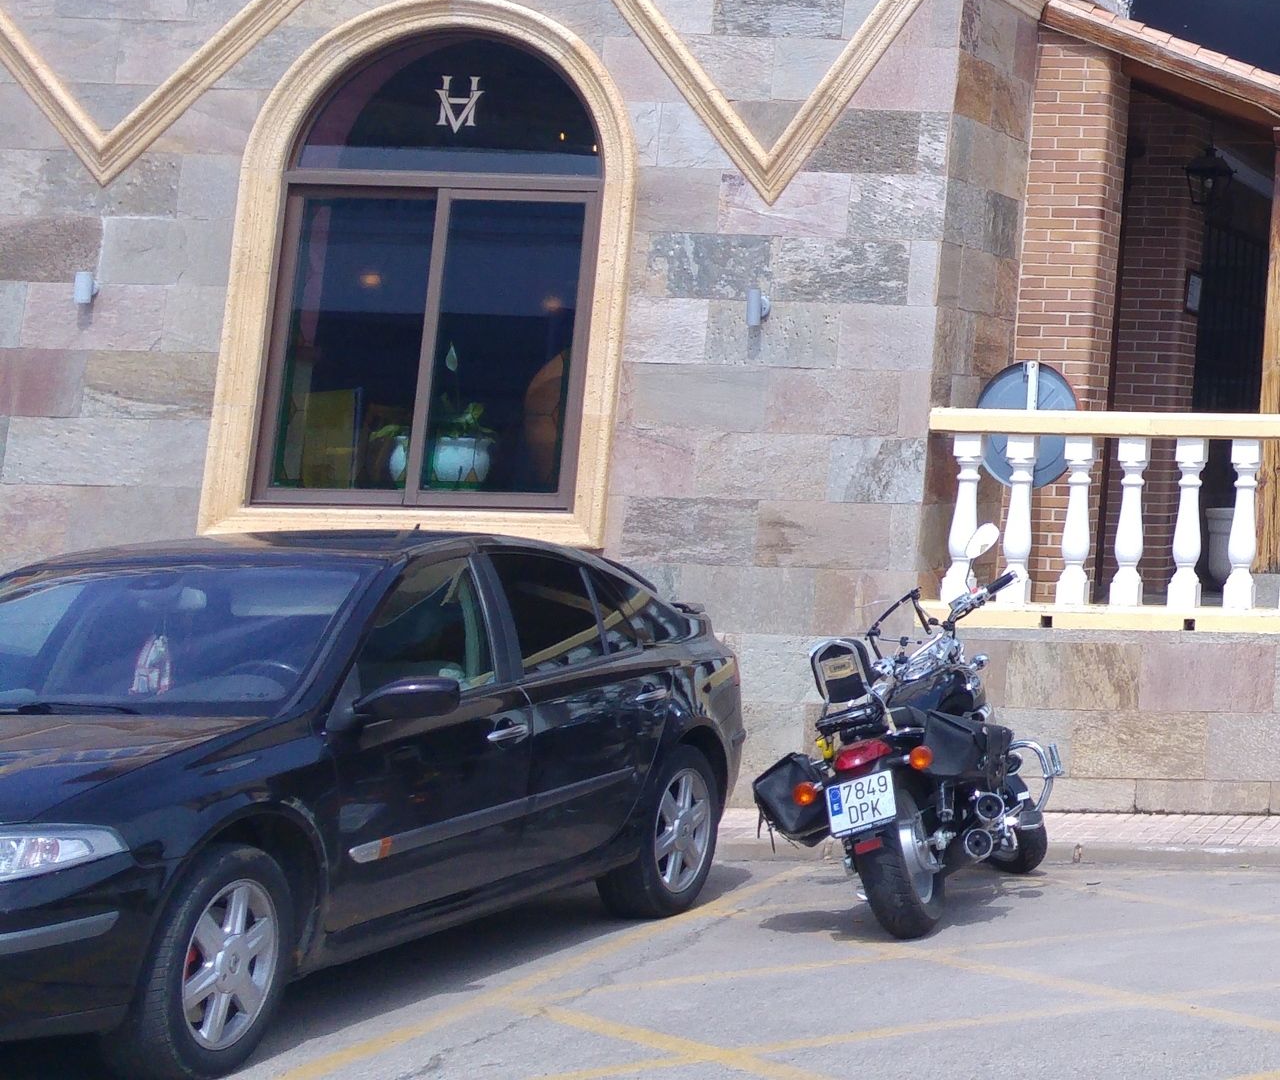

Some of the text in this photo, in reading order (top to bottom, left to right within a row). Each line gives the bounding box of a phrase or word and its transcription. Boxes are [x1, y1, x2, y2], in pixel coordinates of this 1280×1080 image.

[843, 775, 889, 804] 7849
[833, 802, 841, 812] E
[848, 797, 883, 825] DPK
